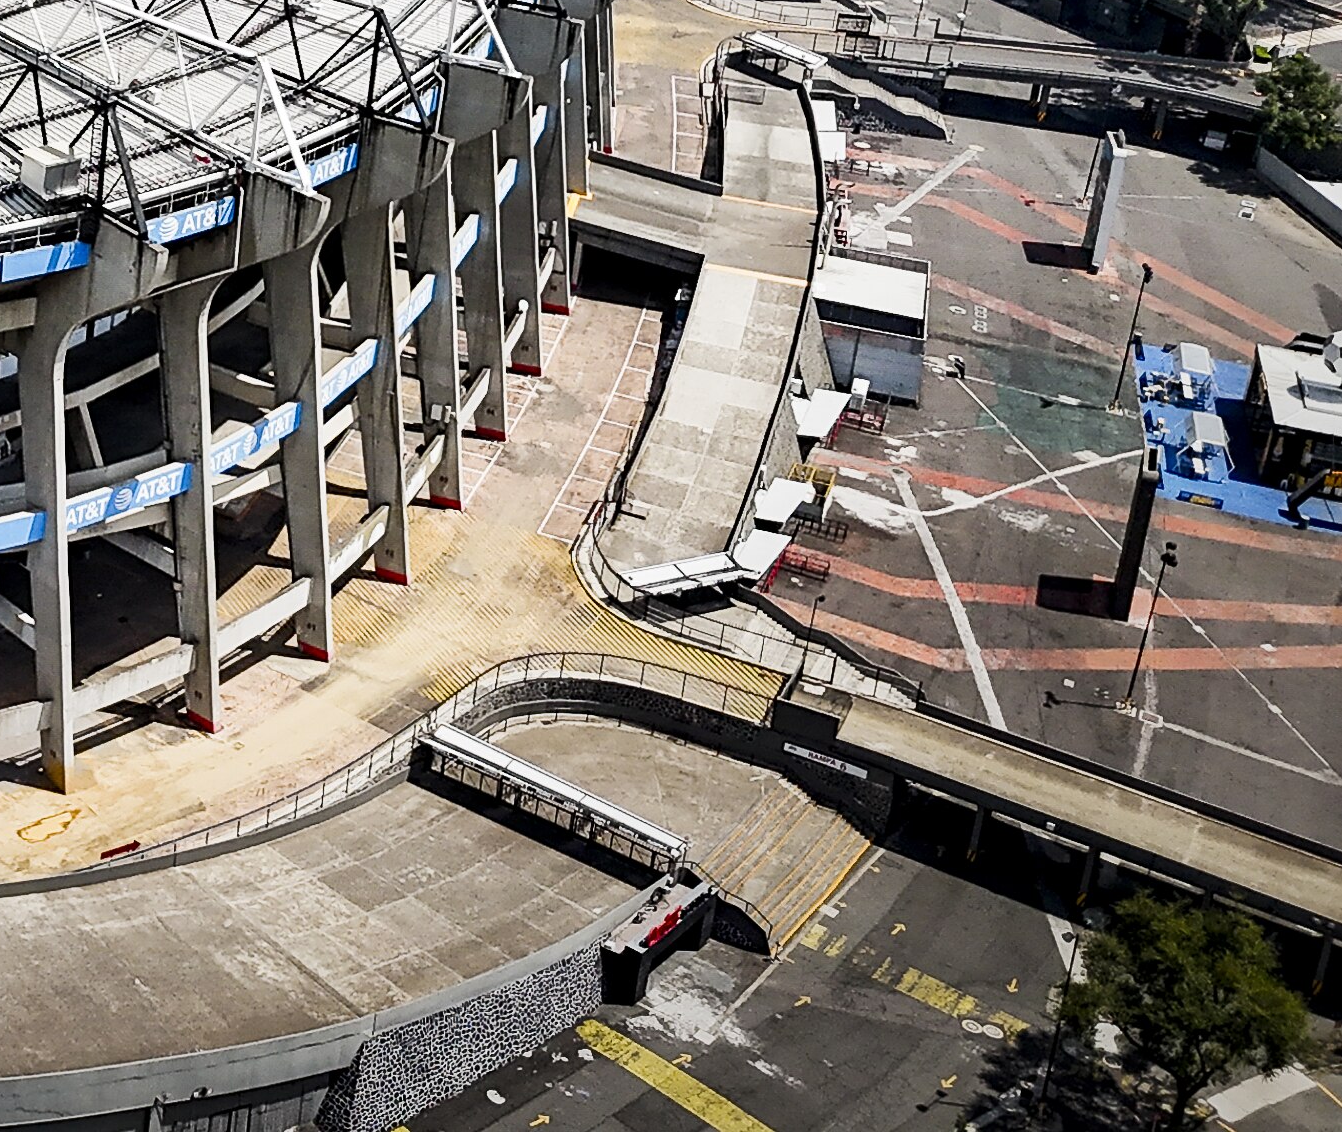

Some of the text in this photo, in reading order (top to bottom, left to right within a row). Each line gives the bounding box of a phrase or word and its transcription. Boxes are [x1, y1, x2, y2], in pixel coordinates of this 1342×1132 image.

[314, 151, 348, 179] AT&T
[181, 199, 226, 234] AT&T
[259, 414, 293, 442] AT&T
[67, 474, 182, 525] AT&T AT&T
